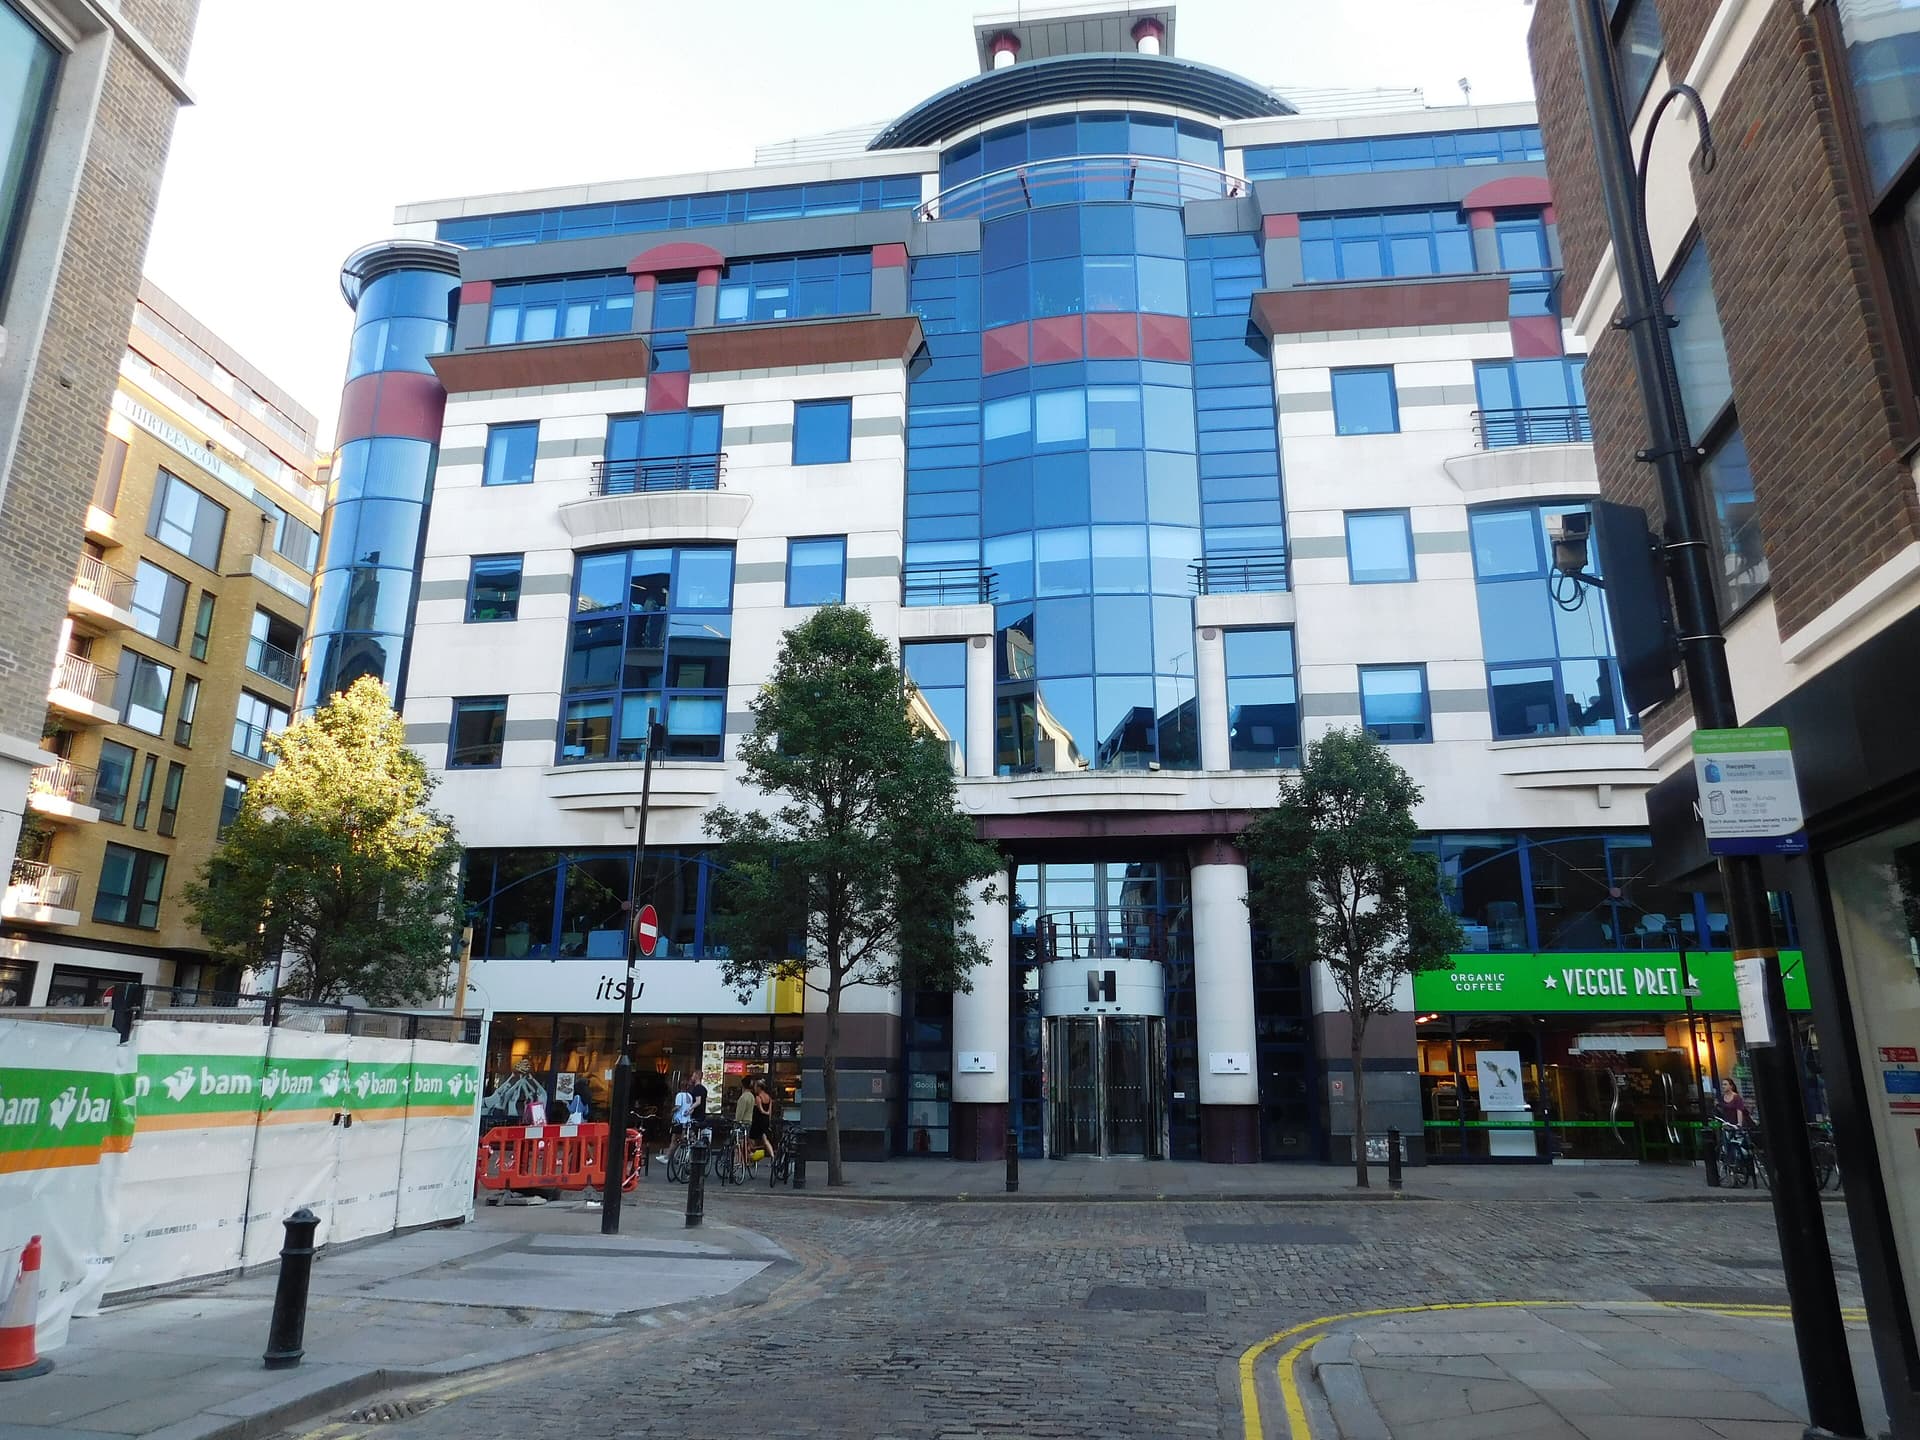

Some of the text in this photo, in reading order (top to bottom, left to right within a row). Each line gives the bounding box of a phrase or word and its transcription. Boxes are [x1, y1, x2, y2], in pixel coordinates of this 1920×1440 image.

[1087, 970, 1117, 1002] H
[1450, 973, 1506, 982] ORGANIC
[1455, 982, 1503, 992] COFFEE
[1562, 967, 1679, 996] VEGGIE PRET
[200, 1066, 252, 1096] bam
[281, 1069, 313, 1095] bam
[371, 1072, 397, 1095] bam
[414, 1072, 443, 1094] bam
